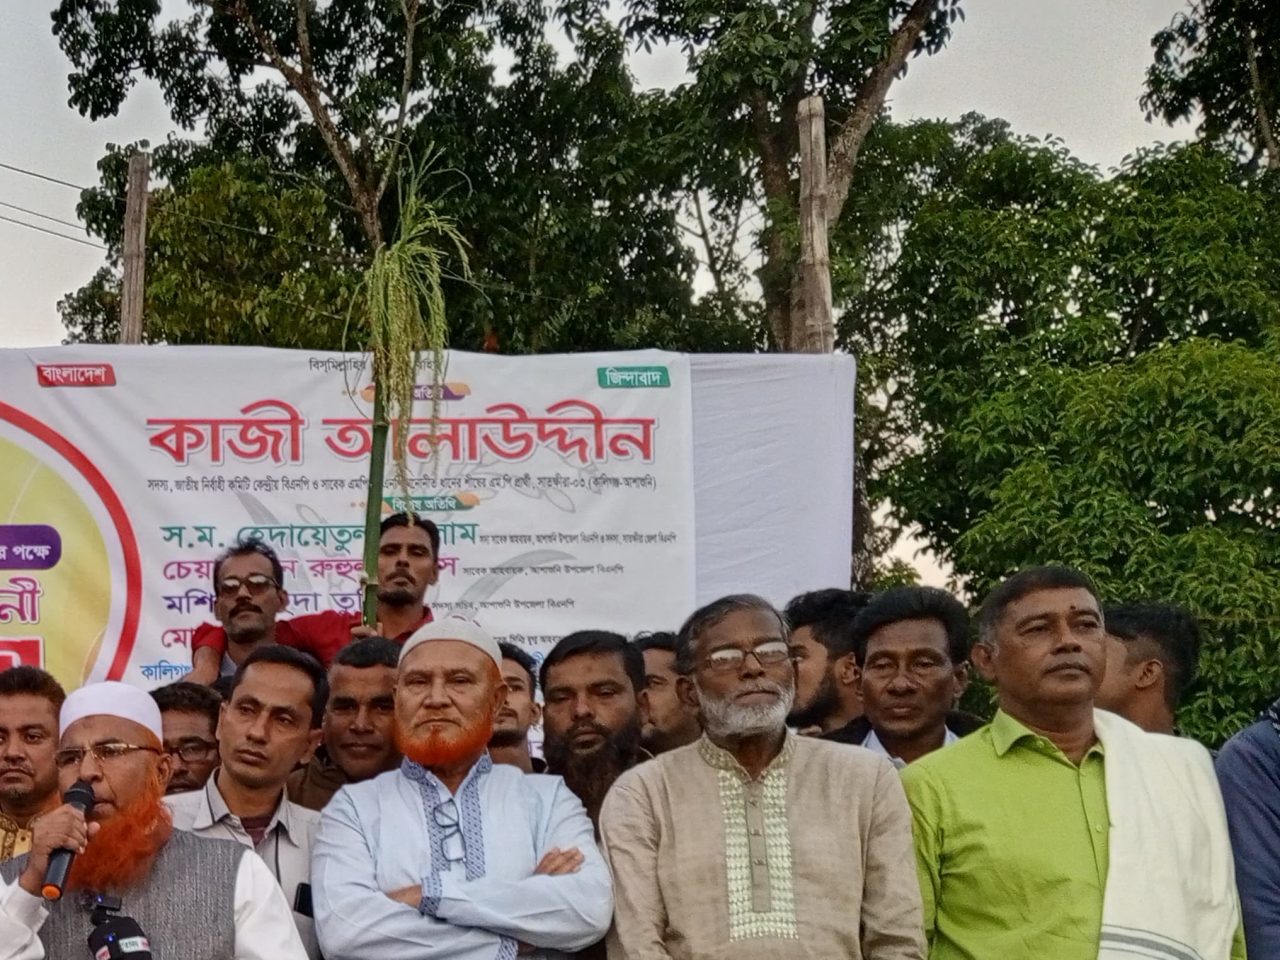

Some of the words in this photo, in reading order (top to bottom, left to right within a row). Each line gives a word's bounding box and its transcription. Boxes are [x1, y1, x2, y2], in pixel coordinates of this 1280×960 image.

[41, 367, 106, 382] বাংলাদেশ
[605, 367, 662, 385] জিন্দাবাদ
[147, 399, 306, 464] কাজী
[228, 476, 251, 490] কমিটি
[281, 475, 310, 491] বিএনপি
[320, 478, 345, 491] সাবেক
[12, 545, 52, 560] পক্ষে
